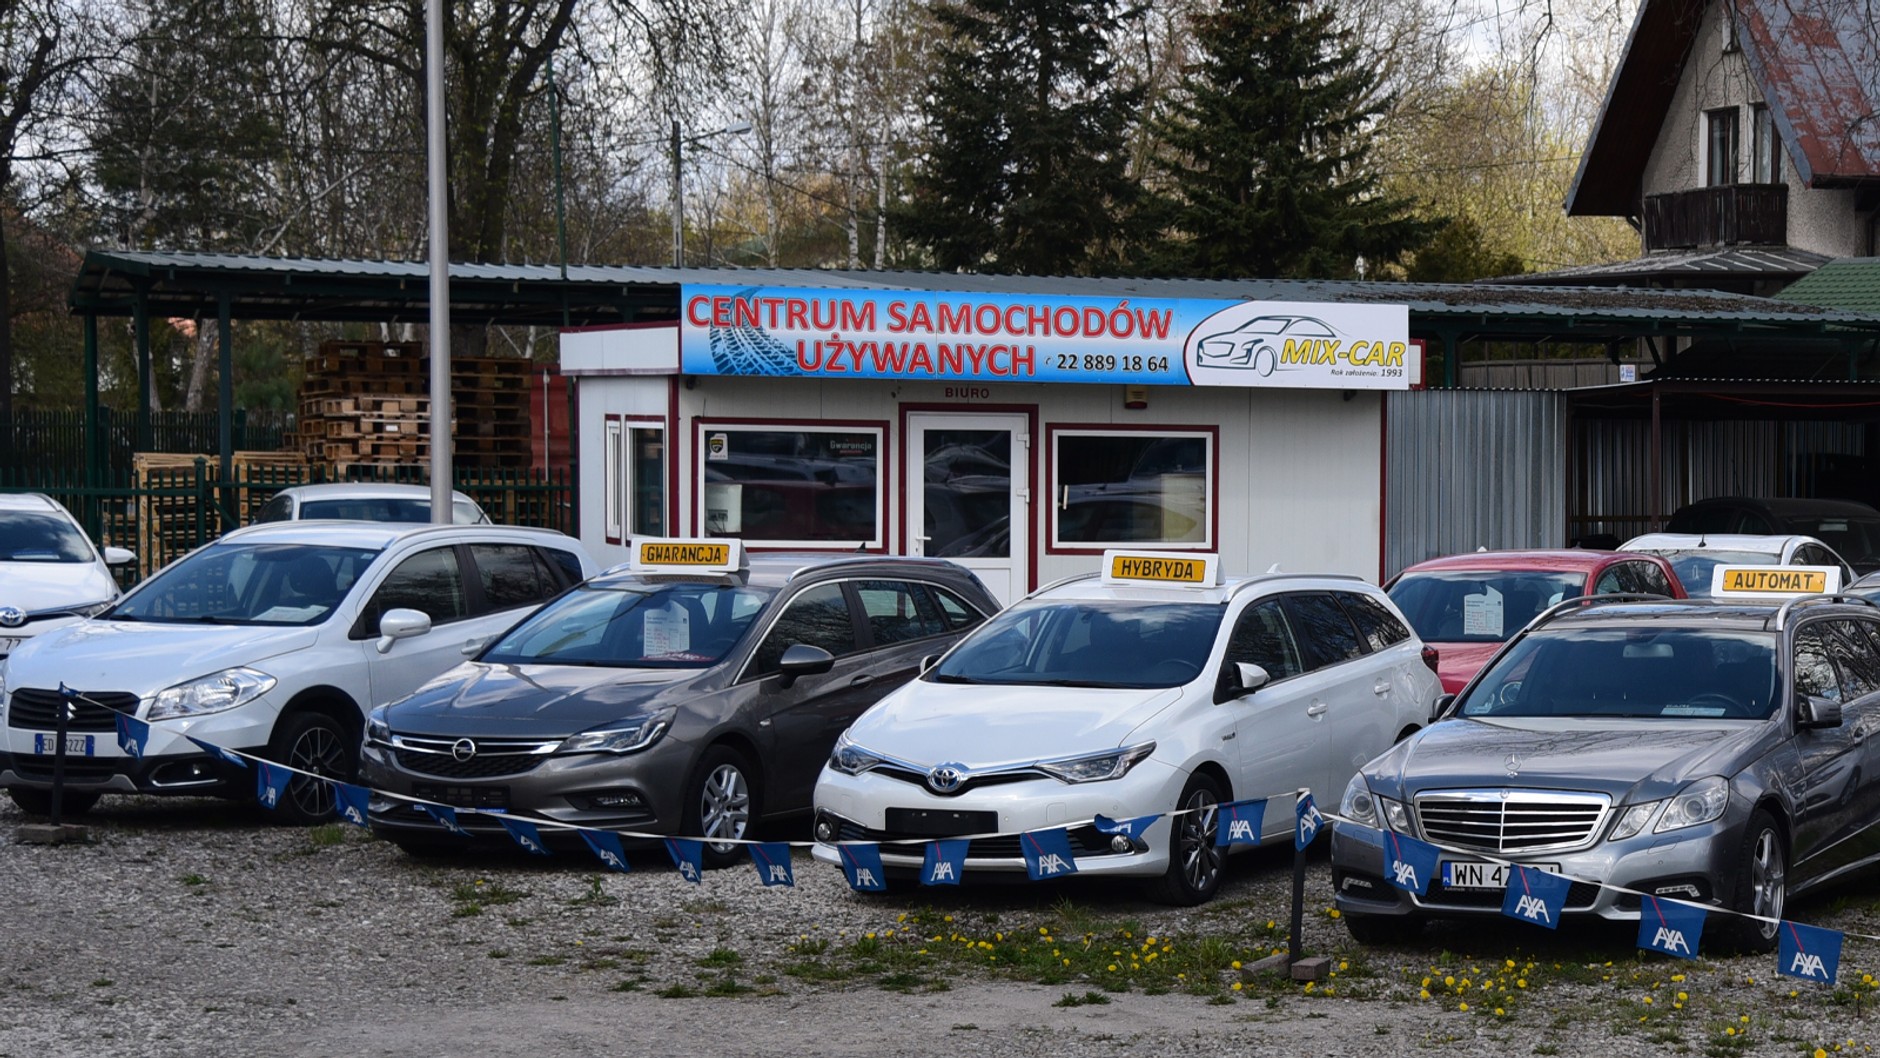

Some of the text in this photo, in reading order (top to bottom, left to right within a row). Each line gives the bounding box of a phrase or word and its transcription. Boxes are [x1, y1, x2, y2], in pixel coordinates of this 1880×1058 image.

[687, 295, 1173, 339] CENTRUM SAMOCHODÓW
[796, 333, 1036, 376] UŻYWANYCH
[1280, 338, 1406, 367] MIX-CAR
[1057, 354, 1168, 373] 22 889 18 64
[1381, 369, 1403, 377] 1993
[945, 387, 990, 399] BIURO
[647, 546, 722, 562] GWARANCJA
[1121, 559, 1193, 579] HYBRYDA
[1734, 572, 1814, 590] AUTOMAT
[1227, 820, 1255, 841] AXA
[1299, 805, 1323, 842] AXA
[769, 864, 792, 884] AXA
[930, 862, 954, 882] AXA
[1038, 853, 1071, 876] AXA
[1392, 860, 1419, 889] AXA
[856, 868, 878, 887] AXA
[1455, 865, 1483, 885] WN
[1514, 894, 1550, 923] AXA
[1652, 926, 1690, 955] AXA
[1790, 951, 1829, 980] AXA
